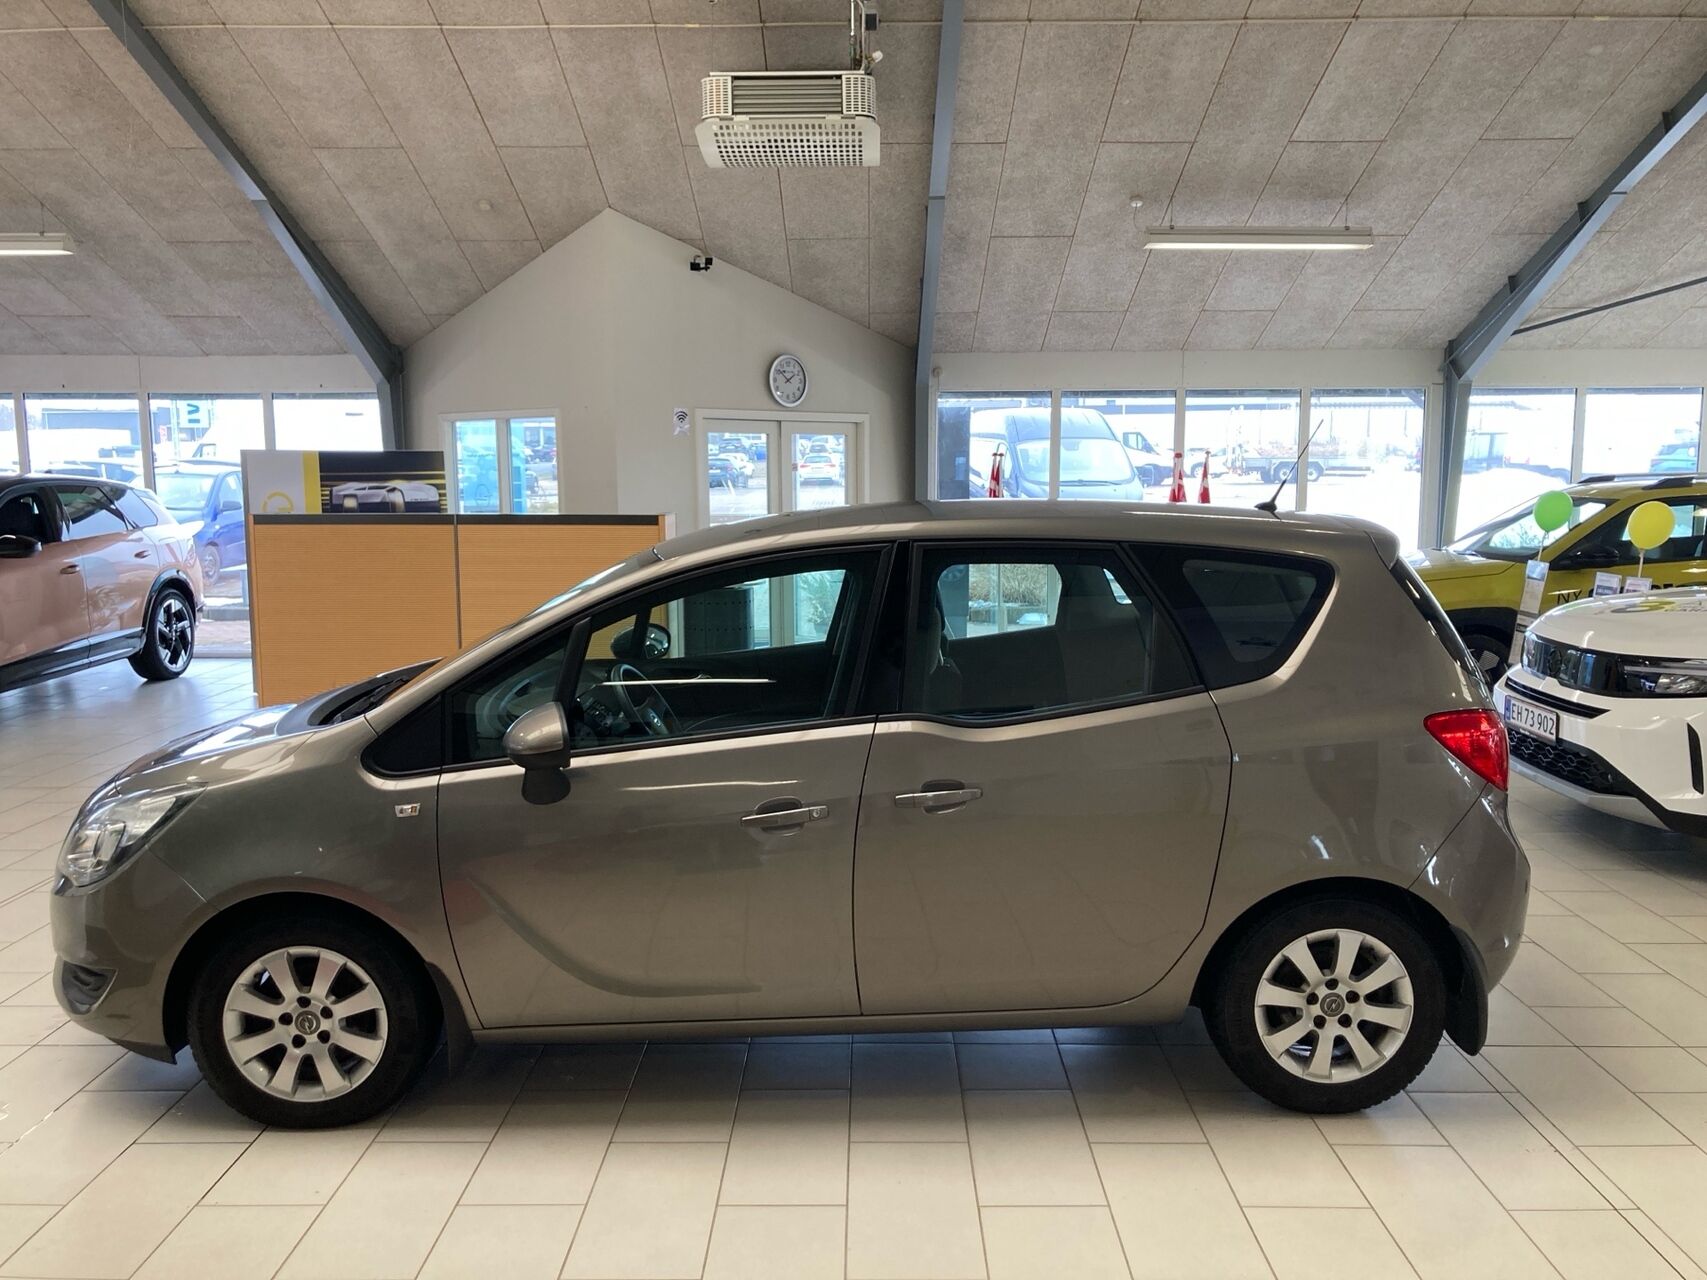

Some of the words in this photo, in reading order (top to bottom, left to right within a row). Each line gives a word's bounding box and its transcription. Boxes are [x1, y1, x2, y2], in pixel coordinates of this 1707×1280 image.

[1557, 590, 1582, 604] NY
[1511, 703, 1523, 722] EH
[1524, 708, 1535, 727] 73
[1537, 712, 1555, 736] 902
